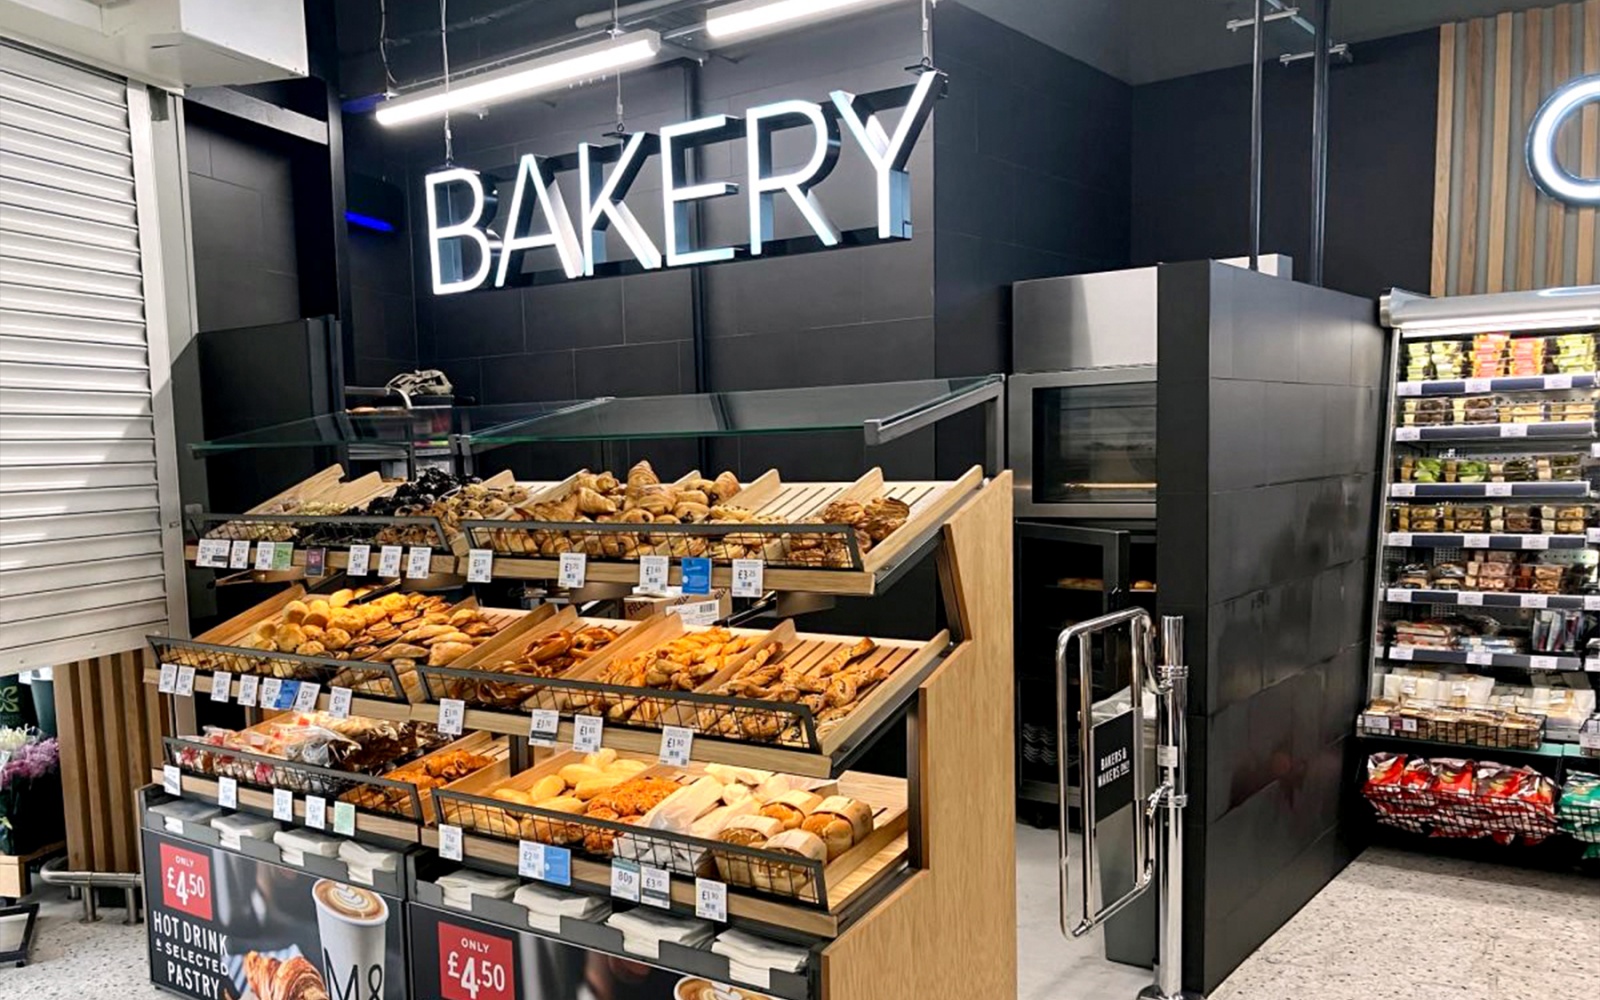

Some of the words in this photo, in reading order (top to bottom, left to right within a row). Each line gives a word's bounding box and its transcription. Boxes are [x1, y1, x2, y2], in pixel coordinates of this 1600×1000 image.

[425, 71, 943, 295] BAKERY
[1097, 765, 1120, 788] MAKERS
[1101, 749, 1122, 771] BAKERS
[175, 854, 195, 869] ONLY
[166, 867, 206, 906] £4.50
[152, 910, 179, 940] HOT
[183, 920, 230, 957] DRINK
[460, 937, 490, 954] ONLY
[164, 941, 230, 977] SELECTED
[447, 951, 505, 1000] £4.50
[166, 960, 220, 1000] PASTRY
